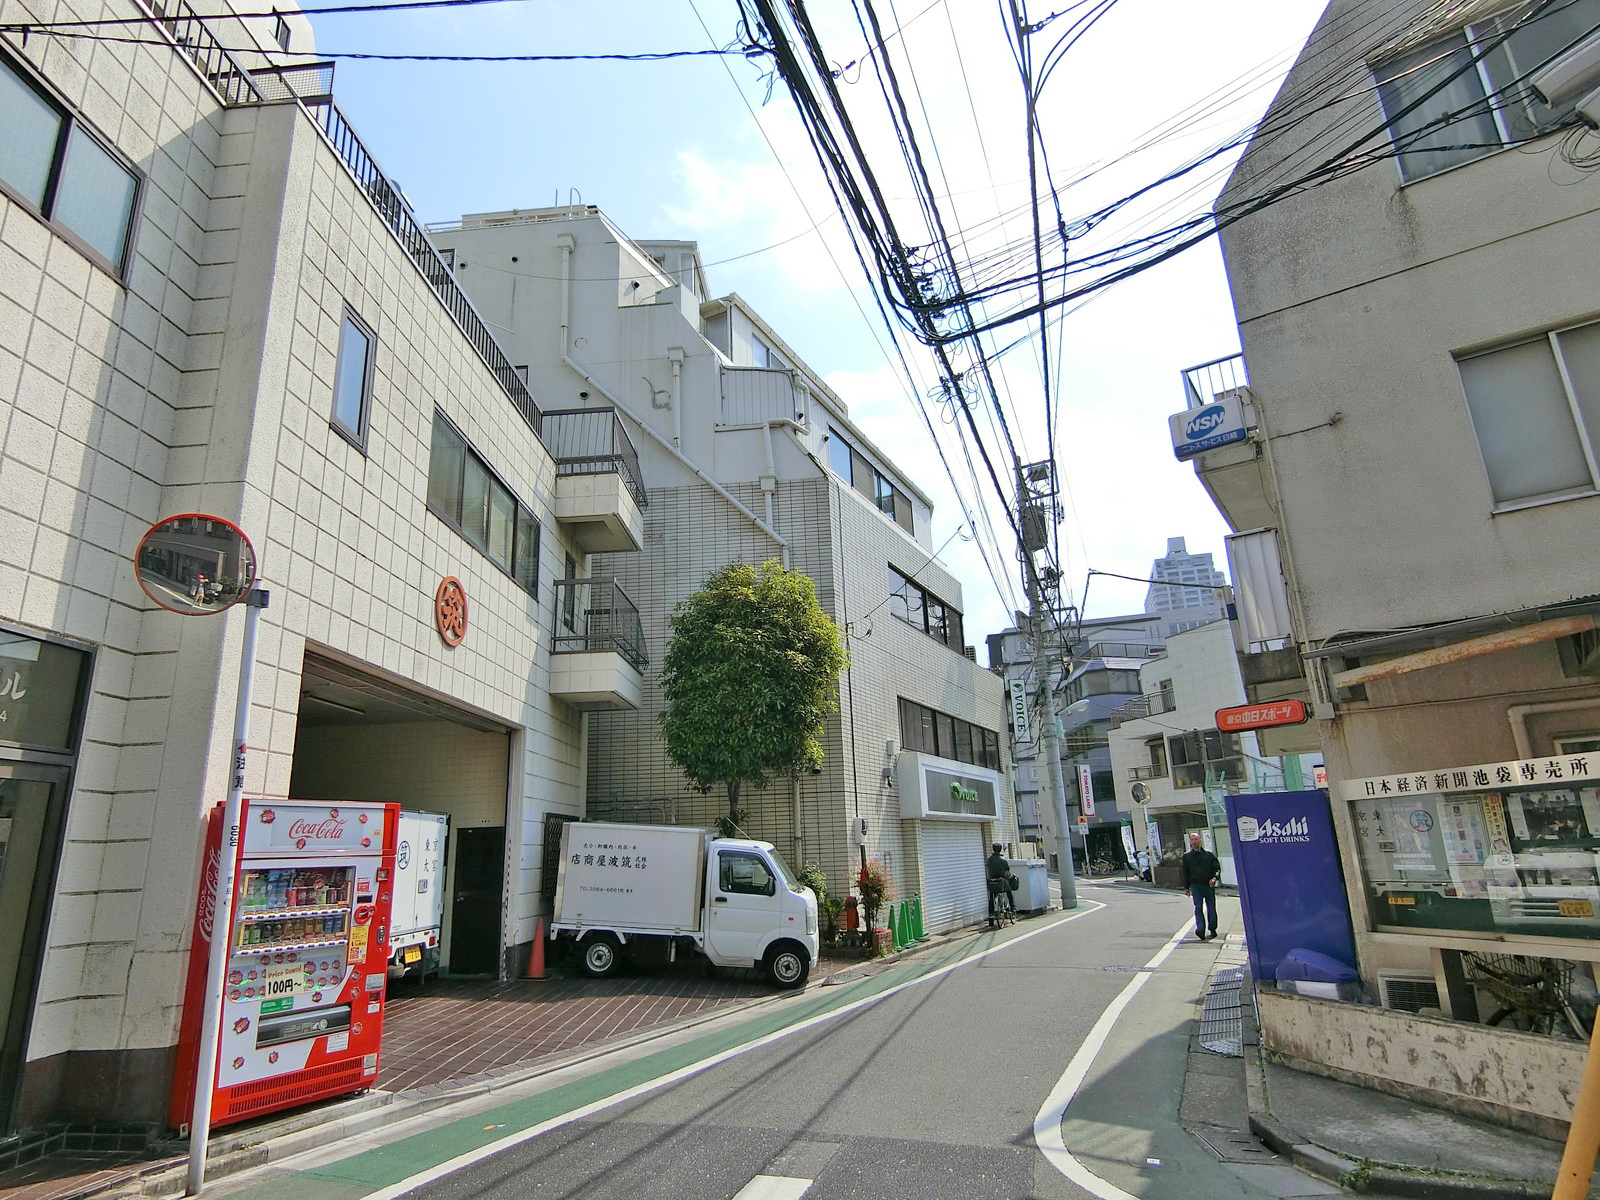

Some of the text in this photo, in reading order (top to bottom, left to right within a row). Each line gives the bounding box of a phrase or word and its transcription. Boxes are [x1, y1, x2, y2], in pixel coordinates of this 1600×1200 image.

[1186, 411, 1225, 434] NSN
[0, 671, 27, 700] ル
[1014, 695, 1026, 732] VOICE
[1226, 705, 1292, 725] 東京中日スポーツ
[1364, 757, 1589, 797] 日本経済新聞池袋専売所
[229, 825, 241, 847] 6030
[288, 817, 347, 839] Coca-Cola
[1258, 815, 1309, 838] Asahi
[1259, 834, 1310, 844] SOFT DRINKS
[267, 970, 285, 979] Price
